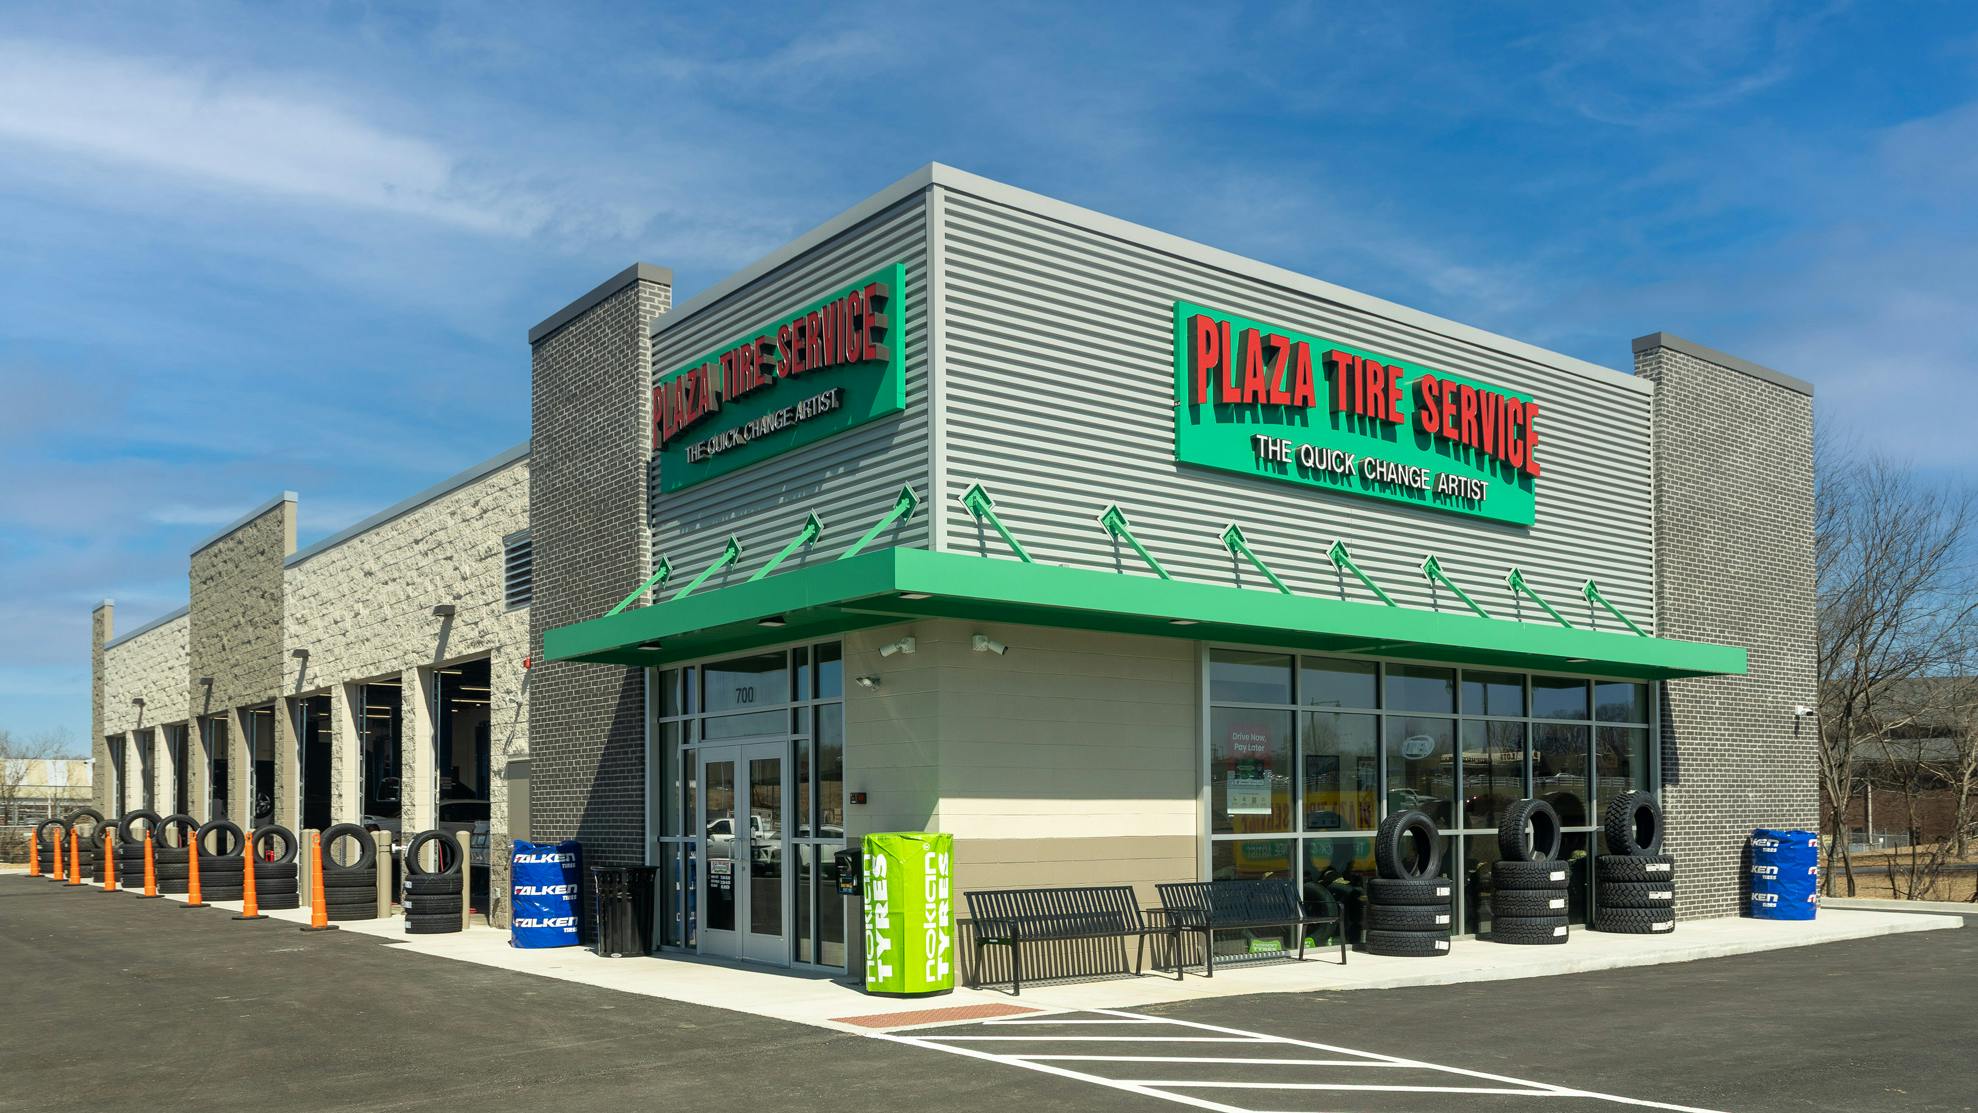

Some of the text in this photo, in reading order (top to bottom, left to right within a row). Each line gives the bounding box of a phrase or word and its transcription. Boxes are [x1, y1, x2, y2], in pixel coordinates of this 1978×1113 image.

[653, 282, 886, 448] PLAZA TIRE SERVICE
[1191, 314, 1541, 477] PLAZA TIRE SERVICE
[687, 387, 839, 463] THE QUICK CHANGE ARTIST
[1256, 434, 1489, 501] THE QUICK CHANGE ARTIST
[736, 686, 754, 704] 700
[1232, 732, 1250, 740] Drive
[1234, 743, 1247, 752] Pay
[873, 853, 893, 983] TYRES
[937, 852, 950, 981] TYRES
